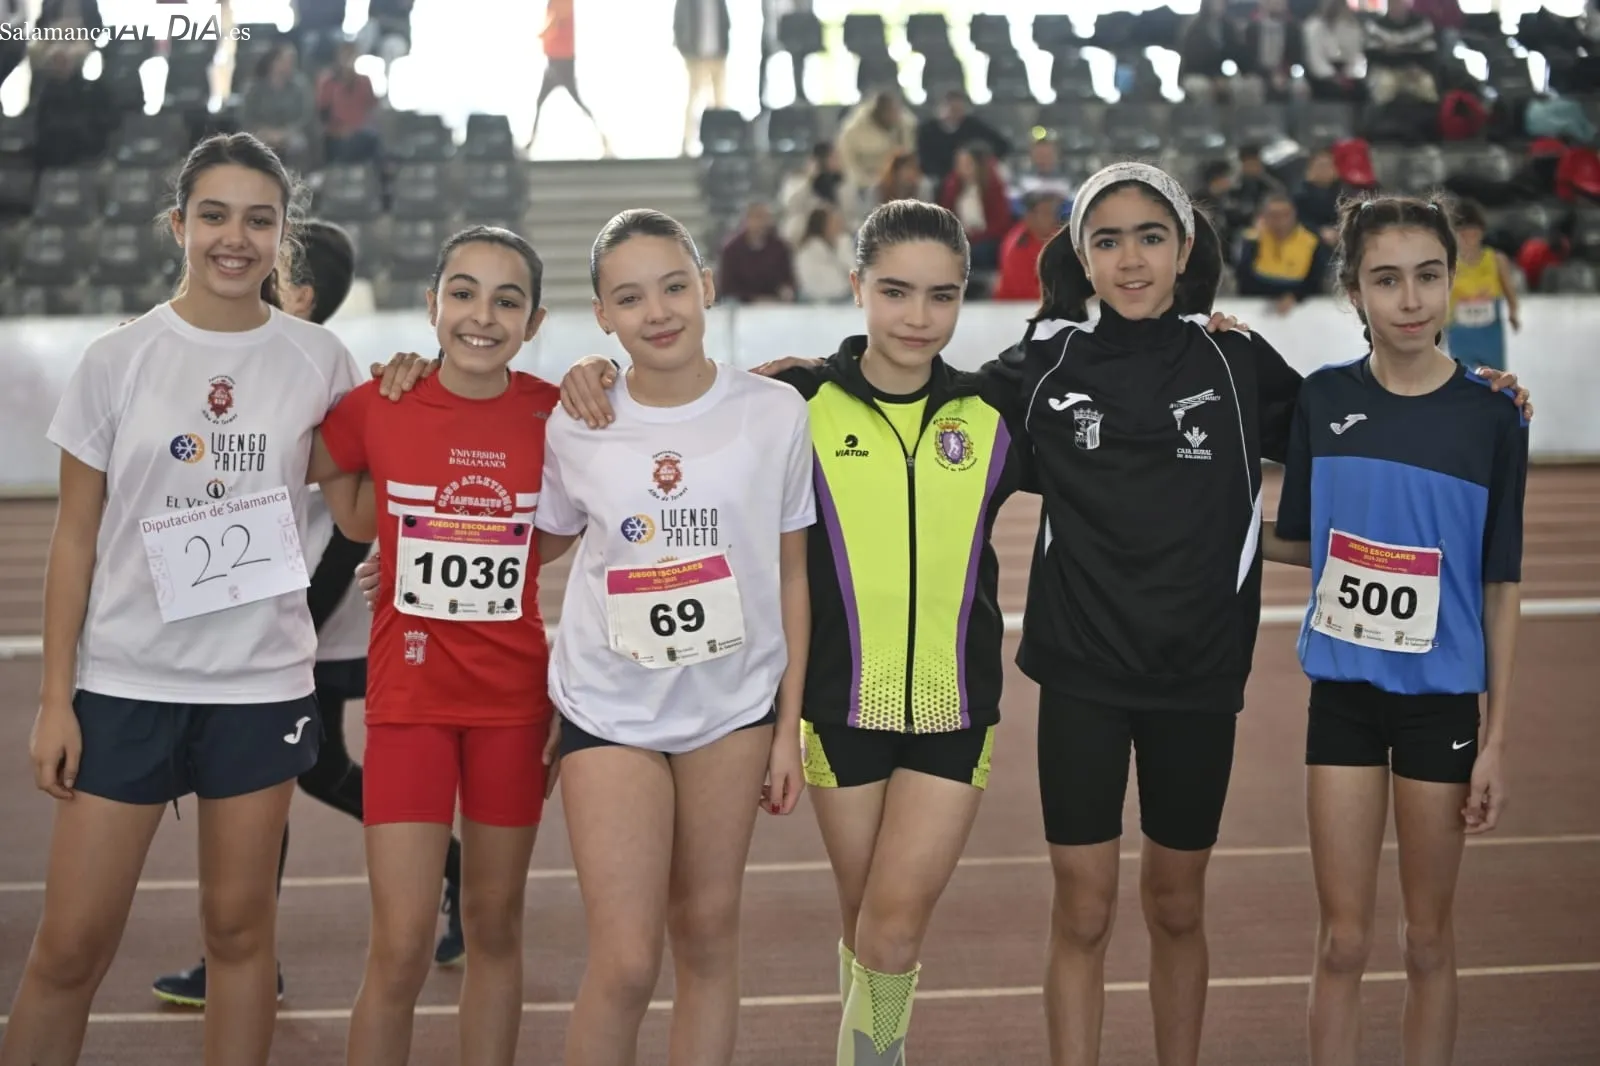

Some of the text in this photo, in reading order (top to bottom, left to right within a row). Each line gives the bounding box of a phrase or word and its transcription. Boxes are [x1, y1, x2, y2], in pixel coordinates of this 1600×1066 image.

[211, 432, 266, 452] LUENGO
[214, 452, 265, 472] PRIETO
[450, 448, 506, 460] VNIVERSIDAD
[456, 457, 506, 468] SALAMANCA
[835, 449, 870, 457] VIATOR
[166, 495, 180, 508] EL
[142, 491, 287, 533] Diputación de Salamanca
[661, 508, 718, 530] LUENGO
[665, 528, 718, 547] PRIETO
[185, 523, 271, 587] 22
[1370, 547, 1417, 561] ESCOLARES
[414, 551, 521, 590] 1036
[1338, 574, 1418, 620] 500
[649, 598, 706, 637] 69
